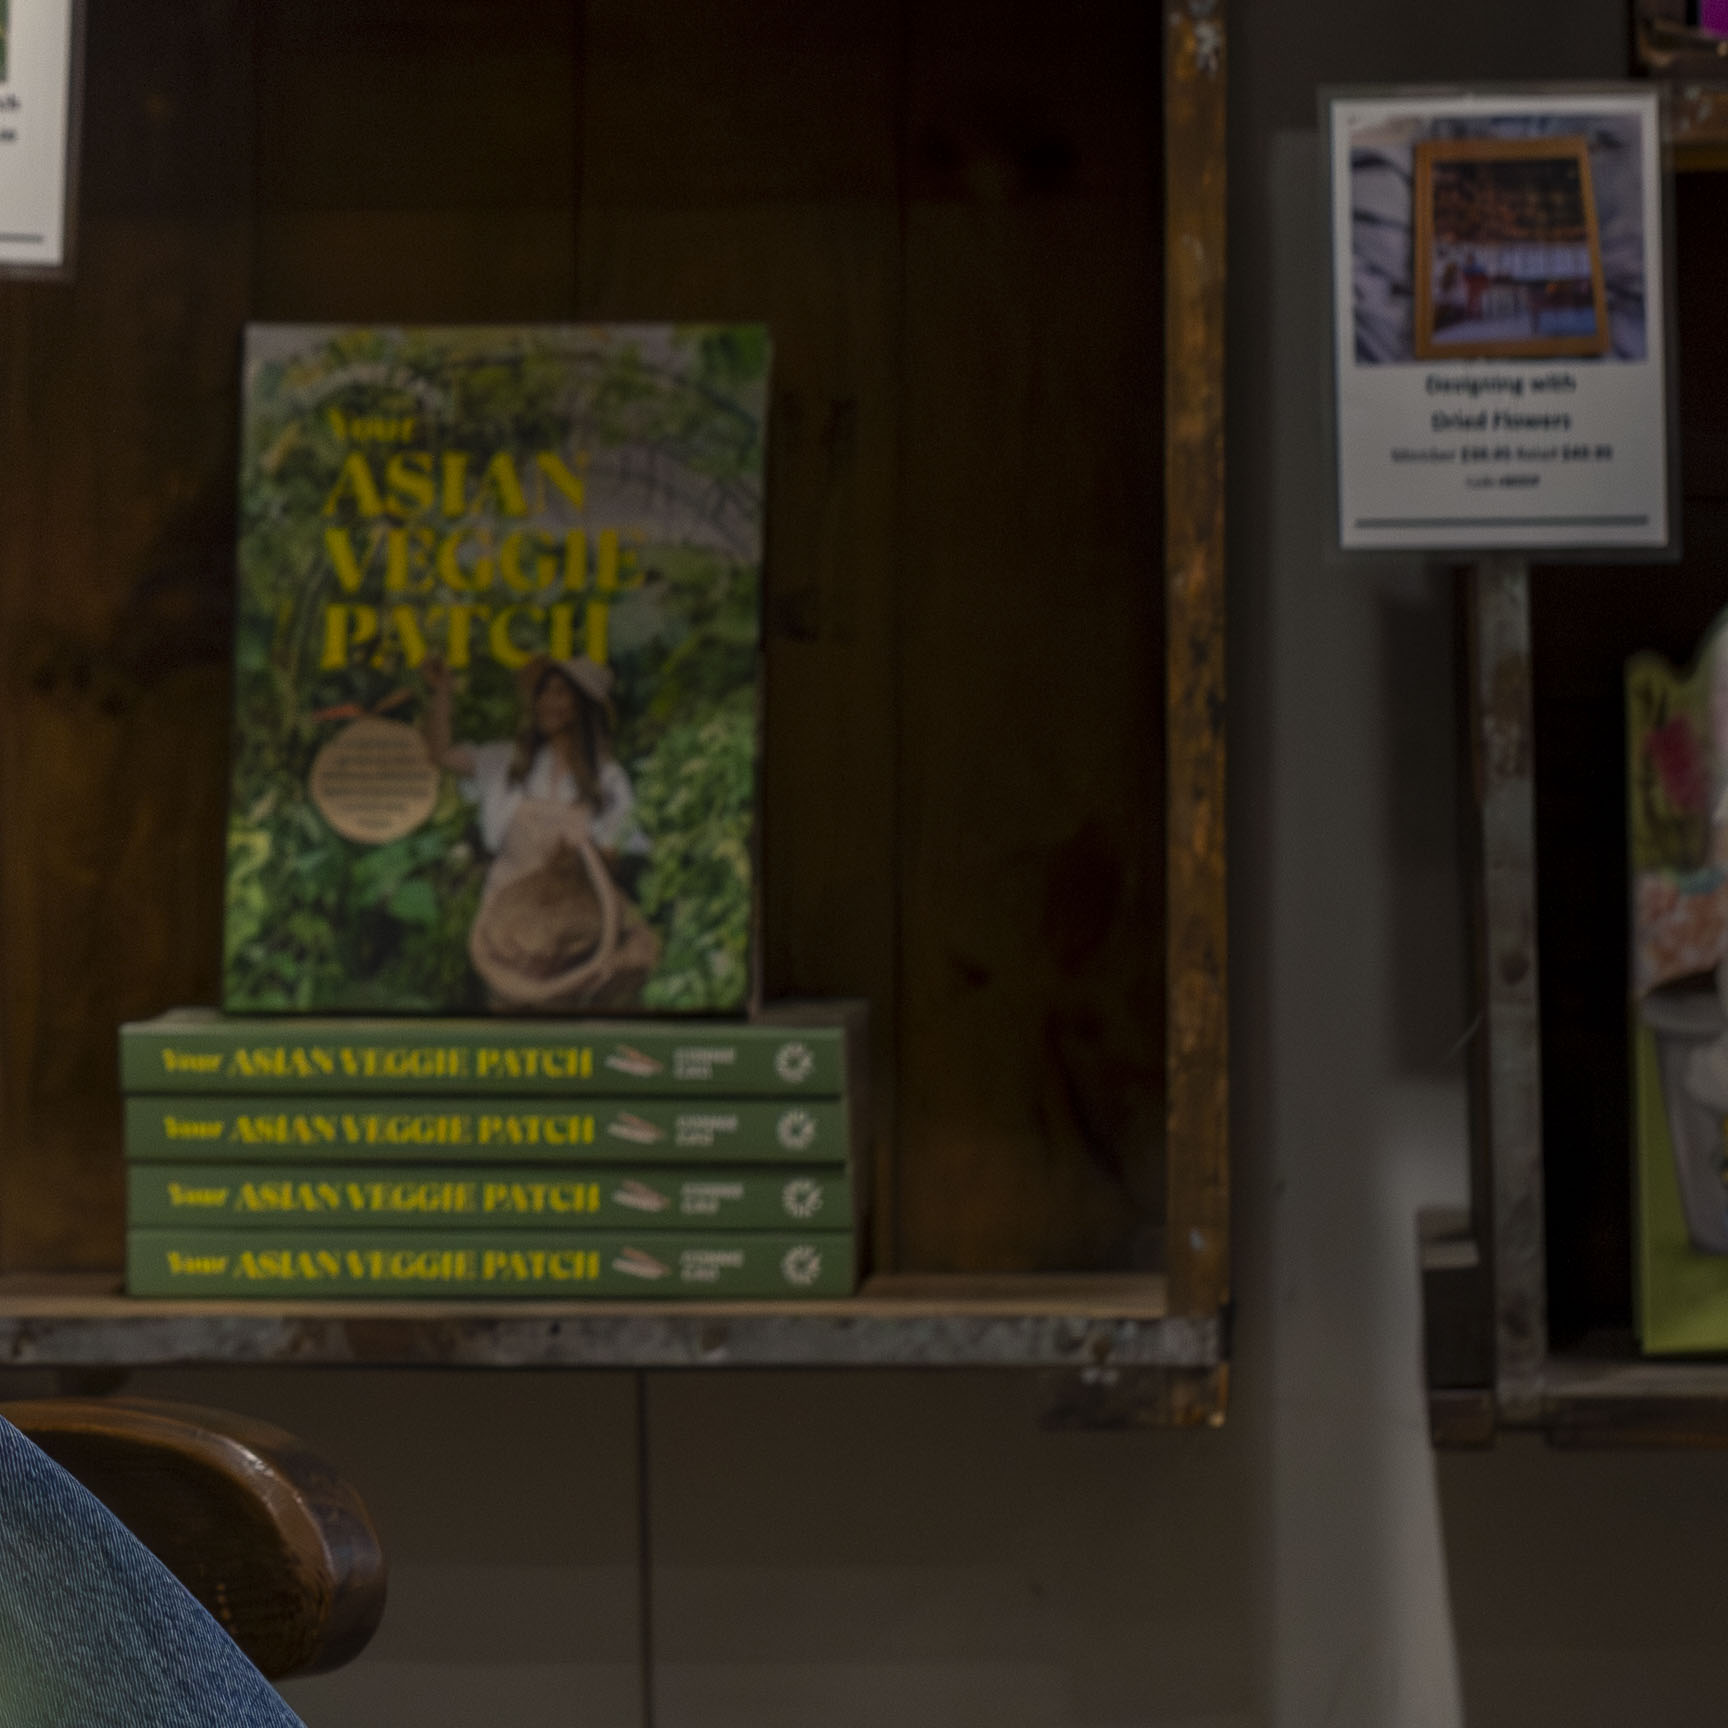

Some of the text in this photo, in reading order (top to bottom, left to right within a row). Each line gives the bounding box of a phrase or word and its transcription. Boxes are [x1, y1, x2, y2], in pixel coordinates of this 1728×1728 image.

[327, 407, 415, 443] Your
[323, 449, 590, 518] ASIAN
[324, 527, 642, 593] VEGGIE
[322, 602, 610, 669] PATCH
[230, 1048, 335, 1077] ASIAN
[340, 1048, 469, 1077] VEGGIE
[476, 1048, 592, 1077] PATCH
[230, 1116, 336, 1145] ASIAN
[343, 1116, 472, 1145] VEGGIE
[478, 1116, 594, 1145] PATCH
[235, 1183, 341, 1212] ASIAN
[347, 1183, 475, 1212] VEGGIE
[483, 1183, 599, 1212] PATCH
[235, 1251, 341, 1280] ASIAN
[347, 1251, 475, 1280] VEGGIE
[483, 1251, 599, 1280] PATCH
